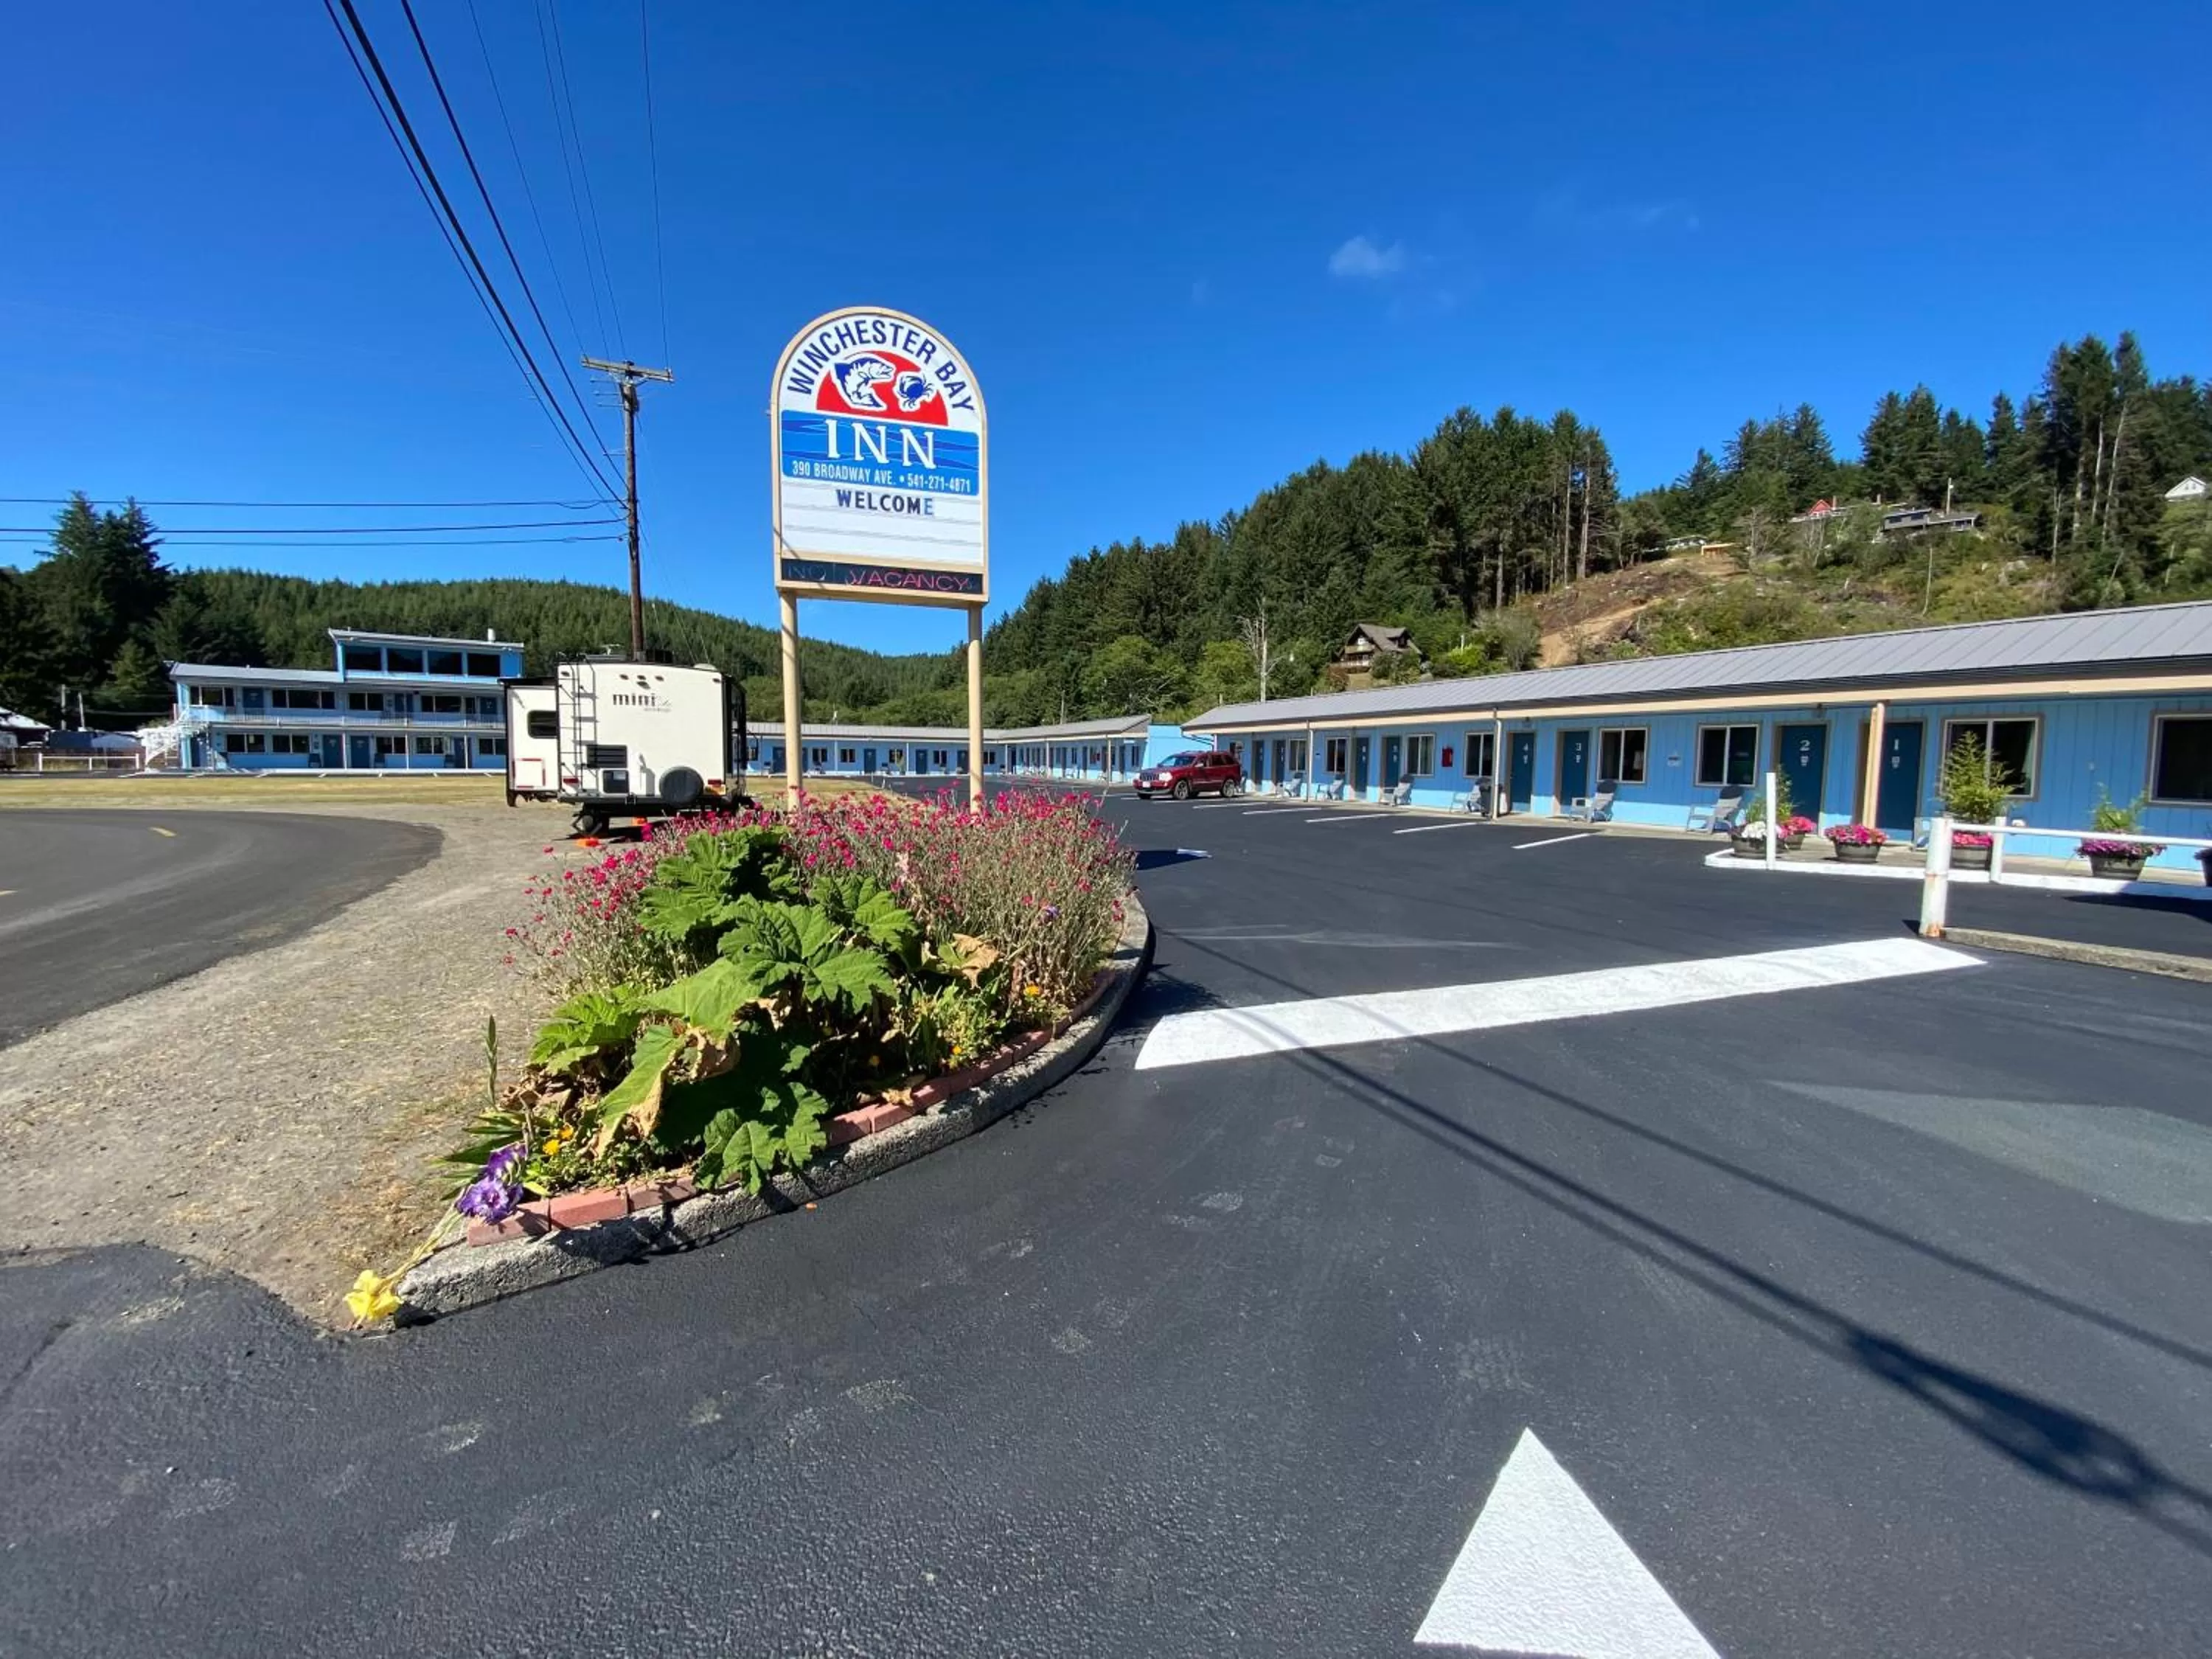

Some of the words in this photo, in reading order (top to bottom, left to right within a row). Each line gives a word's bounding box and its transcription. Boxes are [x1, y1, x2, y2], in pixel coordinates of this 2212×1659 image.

[787, 319, 937, 396] WINCHESTER
[934, 360, 974, 411] BAY
[825, 420, 936, 469] INN
[792, 460, 810, 476] 390
[813, 462, 870, 484] BROADWAY
[874, 471, 897, 485] AVE.
[835, 488, 934, 515] WELCOME
[848, 568, 973, 591] VACANCY
[613, 692, 655, 706] mini
[1799, 740, 1811, 751] 2
